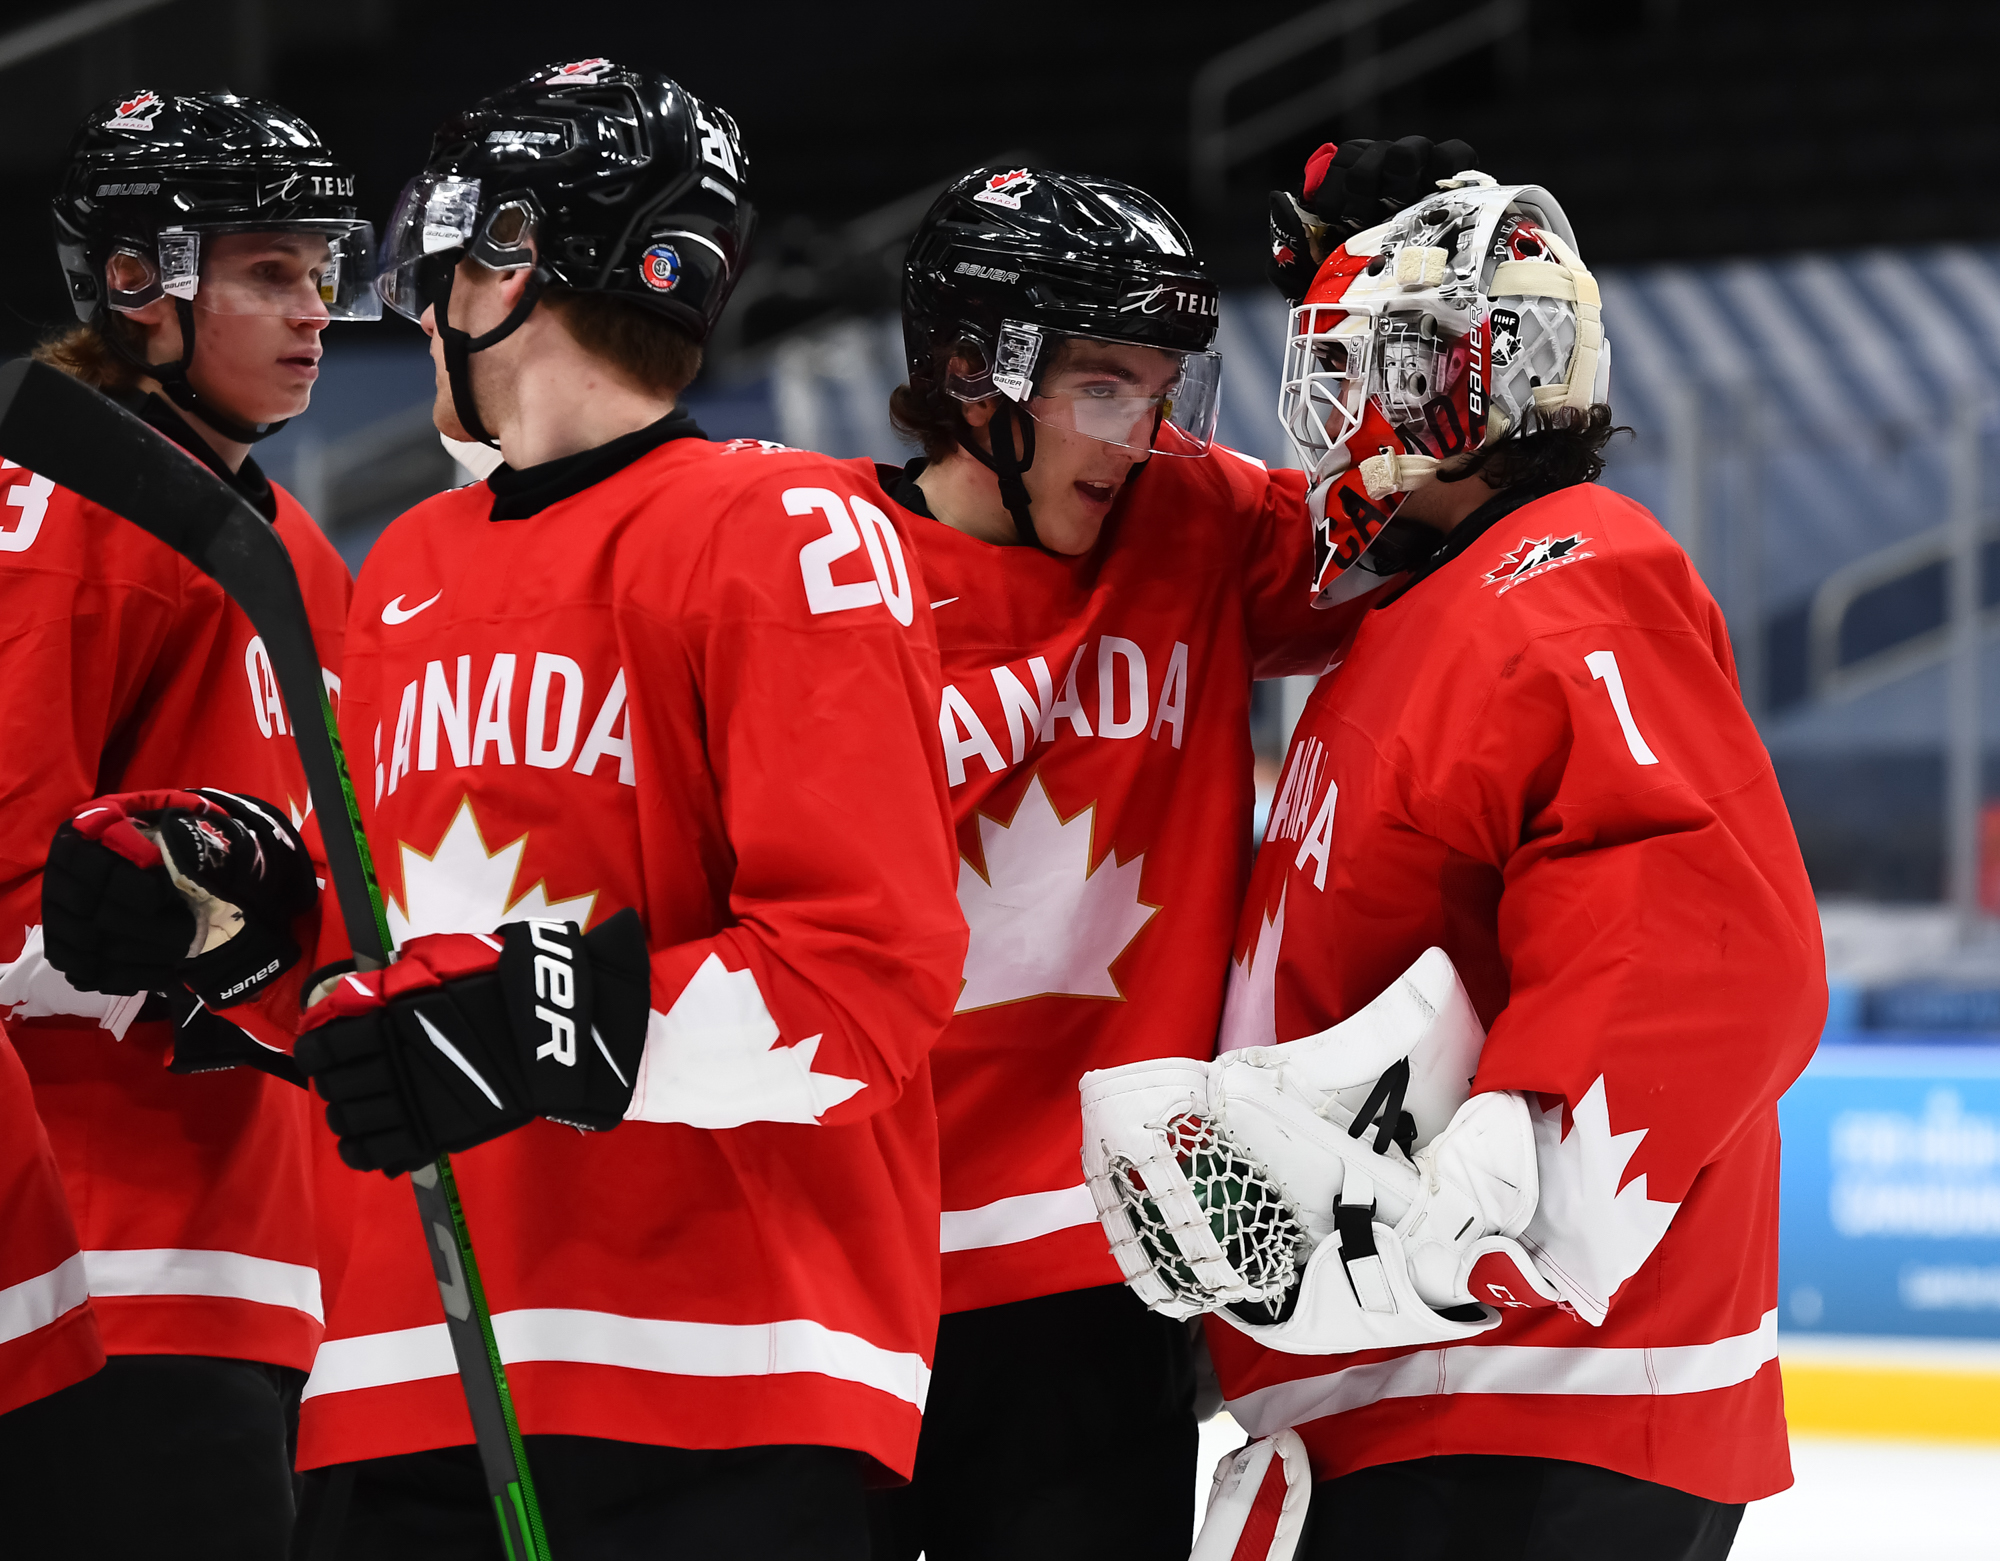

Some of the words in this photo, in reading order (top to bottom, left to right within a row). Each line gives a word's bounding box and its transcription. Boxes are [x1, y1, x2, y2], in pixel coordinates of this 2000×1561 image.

[109, 121, 150, 129] CANADA
[485, 130, 561, 145] BAUER
[696, 118, 739, 183] 20
[97, 182, 160, 197] BAUER
[977, 194, 1018, 207] CANADA
[164, 280, 192, 290] BAUER
[954, 261, 1019, 285] BAUER
[1175, 291, 1220, 317] TELU
[1494, 313, 1516, 326] IIHF
[1469, 303, 1485, 415] BAUER
[993, 375, 1022, 387] BAUER
[0, 458, 56, 552] 3
[781, 487, 914, 627] 20
[1499, 552, 1593, 594] CANADA
[1583, 650, 1660, 766] 1
[373, 651, 637, 812] ANADA
[220, 958, 280, 1000] BAUER
[525, 917, 577, 1067] UER
